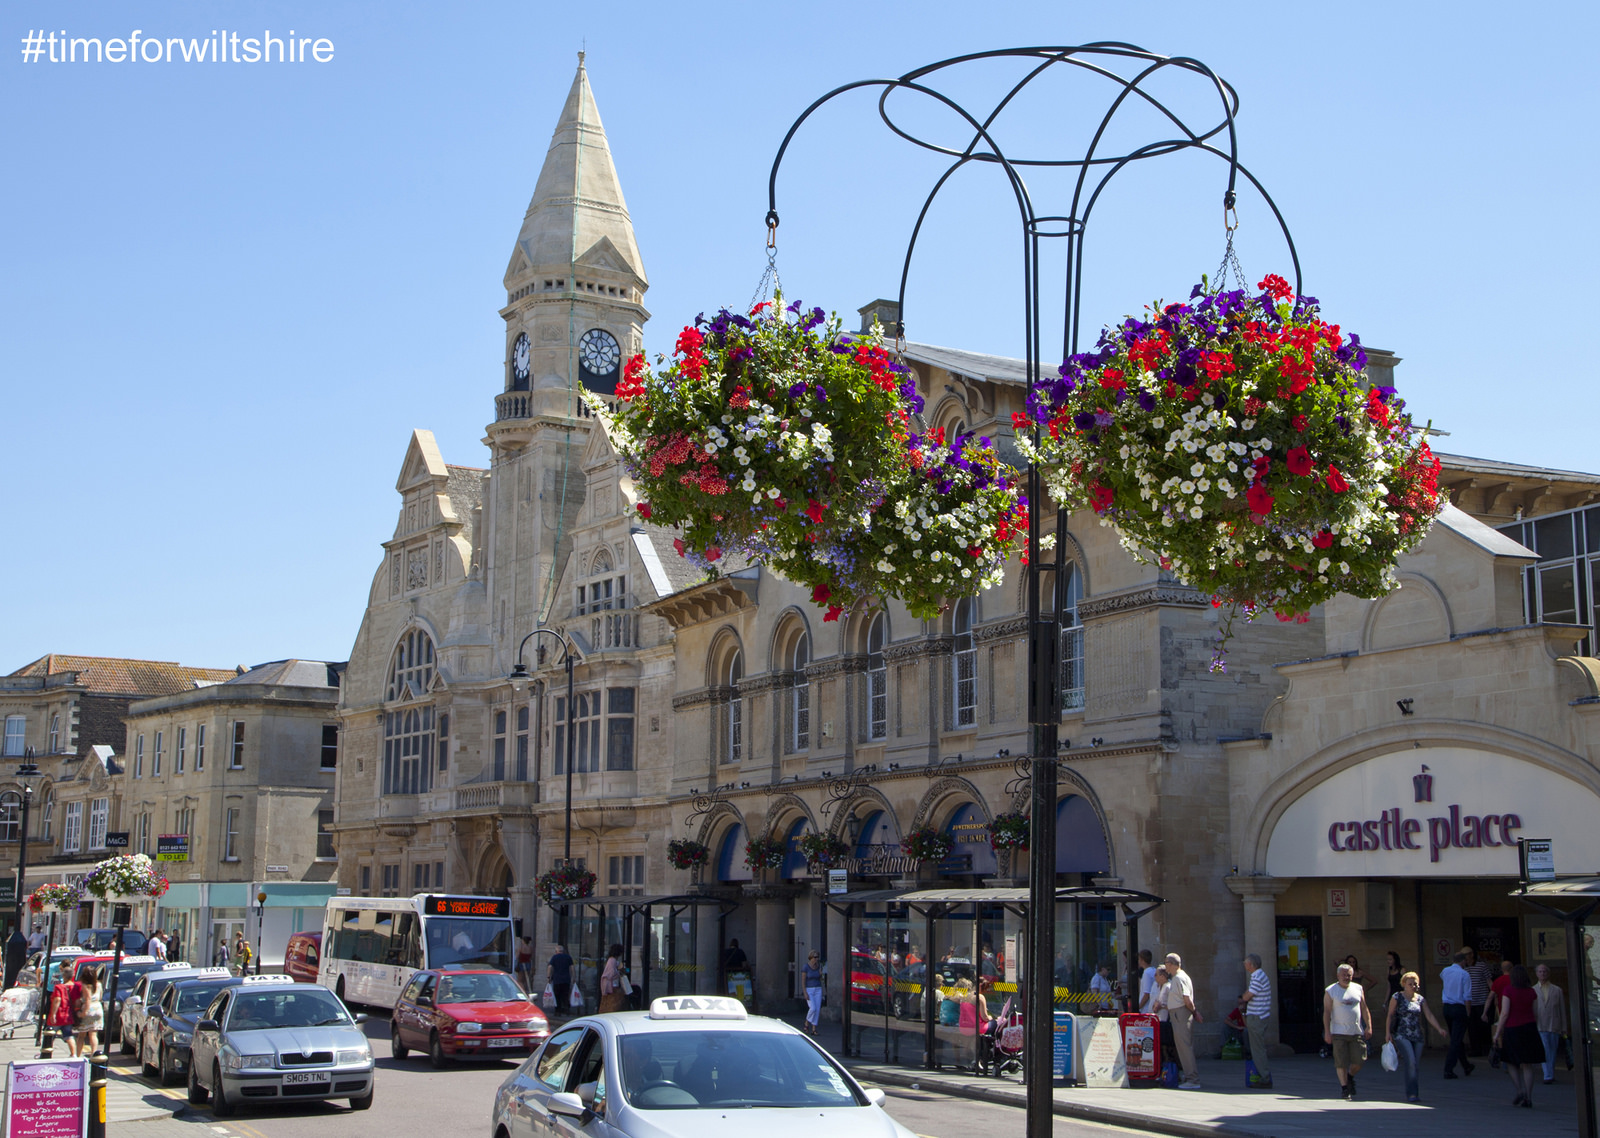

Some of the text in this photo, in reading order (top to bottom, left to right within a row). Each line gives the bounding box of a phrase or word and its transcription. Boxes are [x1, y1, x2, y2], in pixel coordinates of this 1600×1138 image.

[1328, 804, 1521, 863] castle place
[437, 900, 447, 913] 66
[471, 905, 497, 914] CENTRE
[661, 998, 738, 1012] TAXI
[14, 1072, 58, 1083] Passion
[287, 1073, 327, 1083] SM05 TNL
